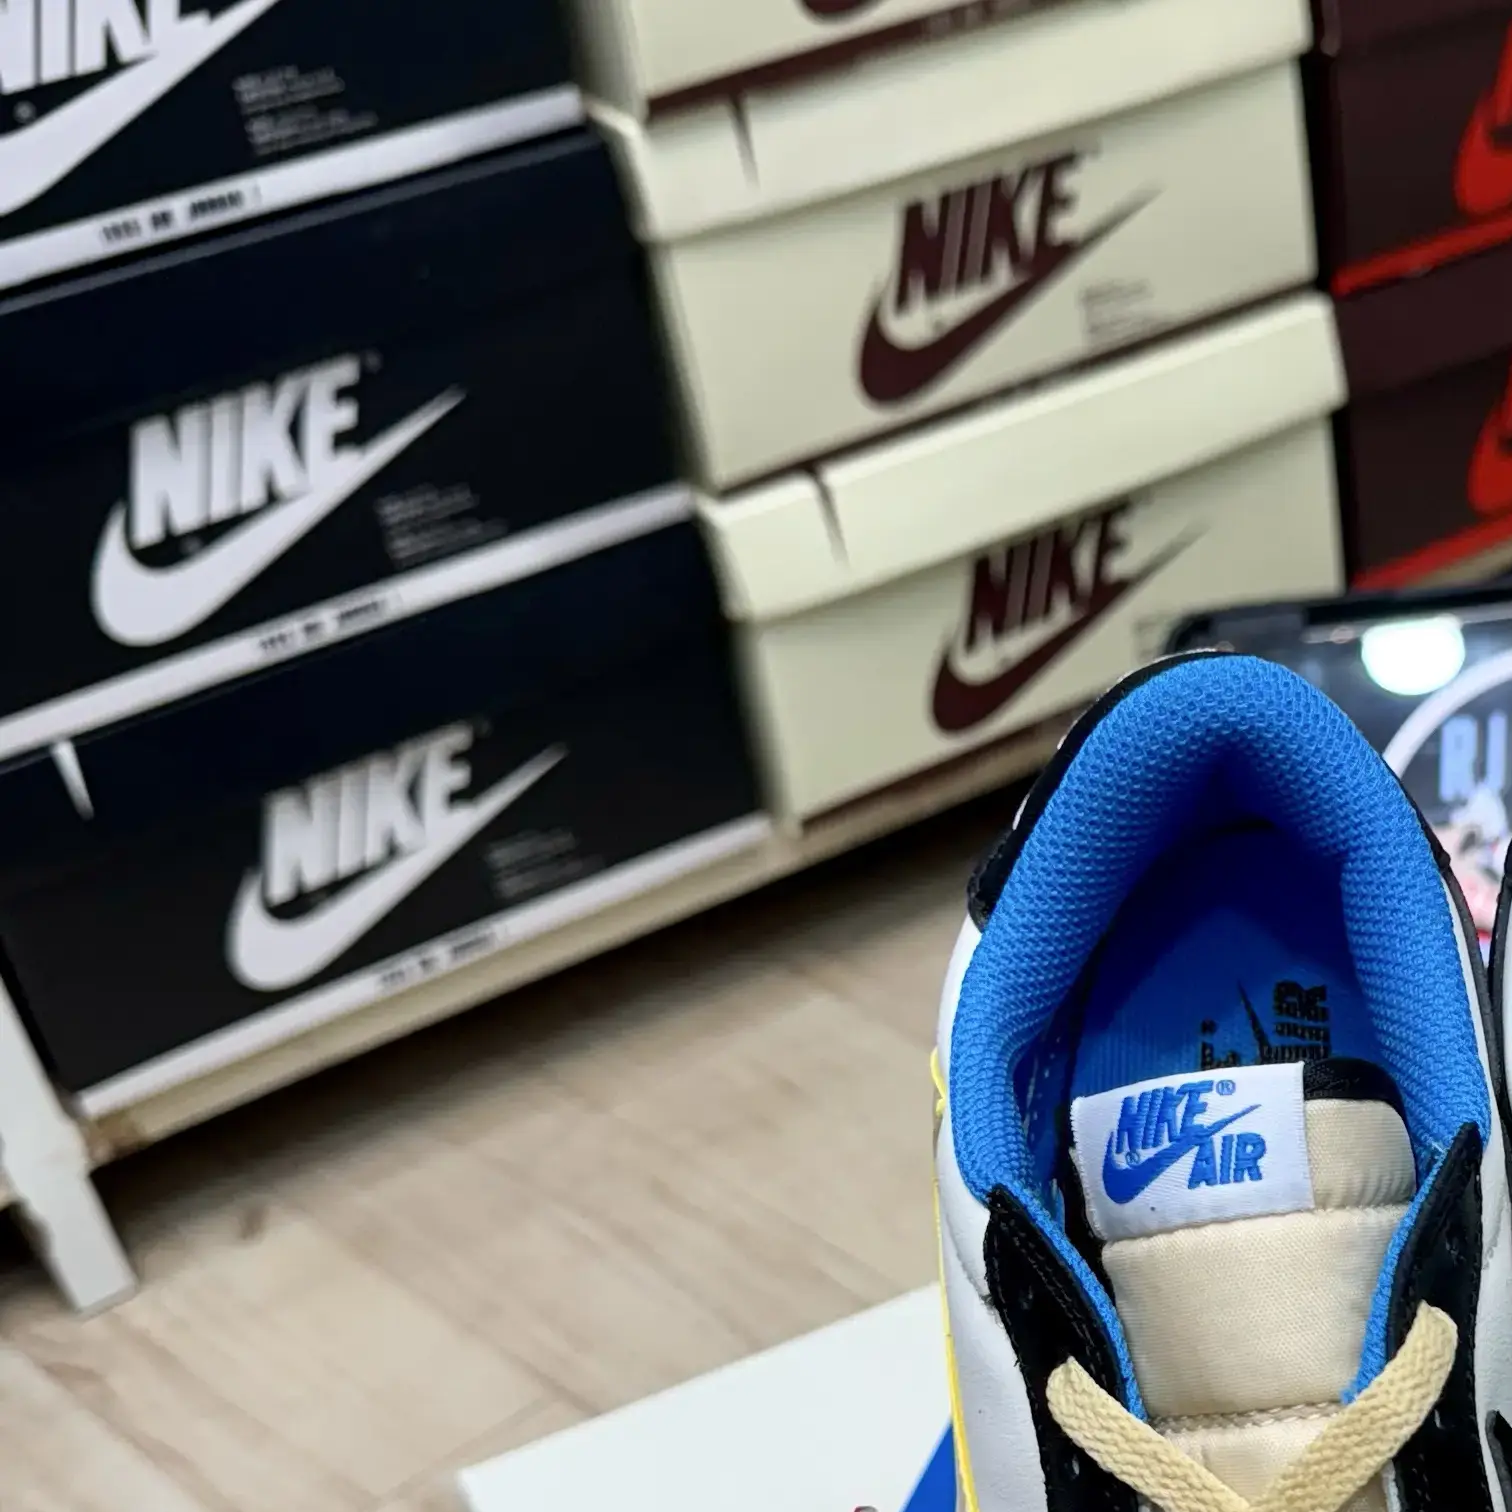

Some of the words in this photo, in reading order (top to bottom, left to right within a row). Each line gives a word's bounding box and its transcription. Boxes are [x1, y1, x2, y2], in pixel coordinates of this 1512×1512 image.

[894, 153, 1084, 314] NIKE
[131, 353, 361, 550] NIKE
[965, 498, 1135, 652] NIKE
[262, 721, 473, 907] NIKE
[1187, 1132, 1267, 1190] AIR
